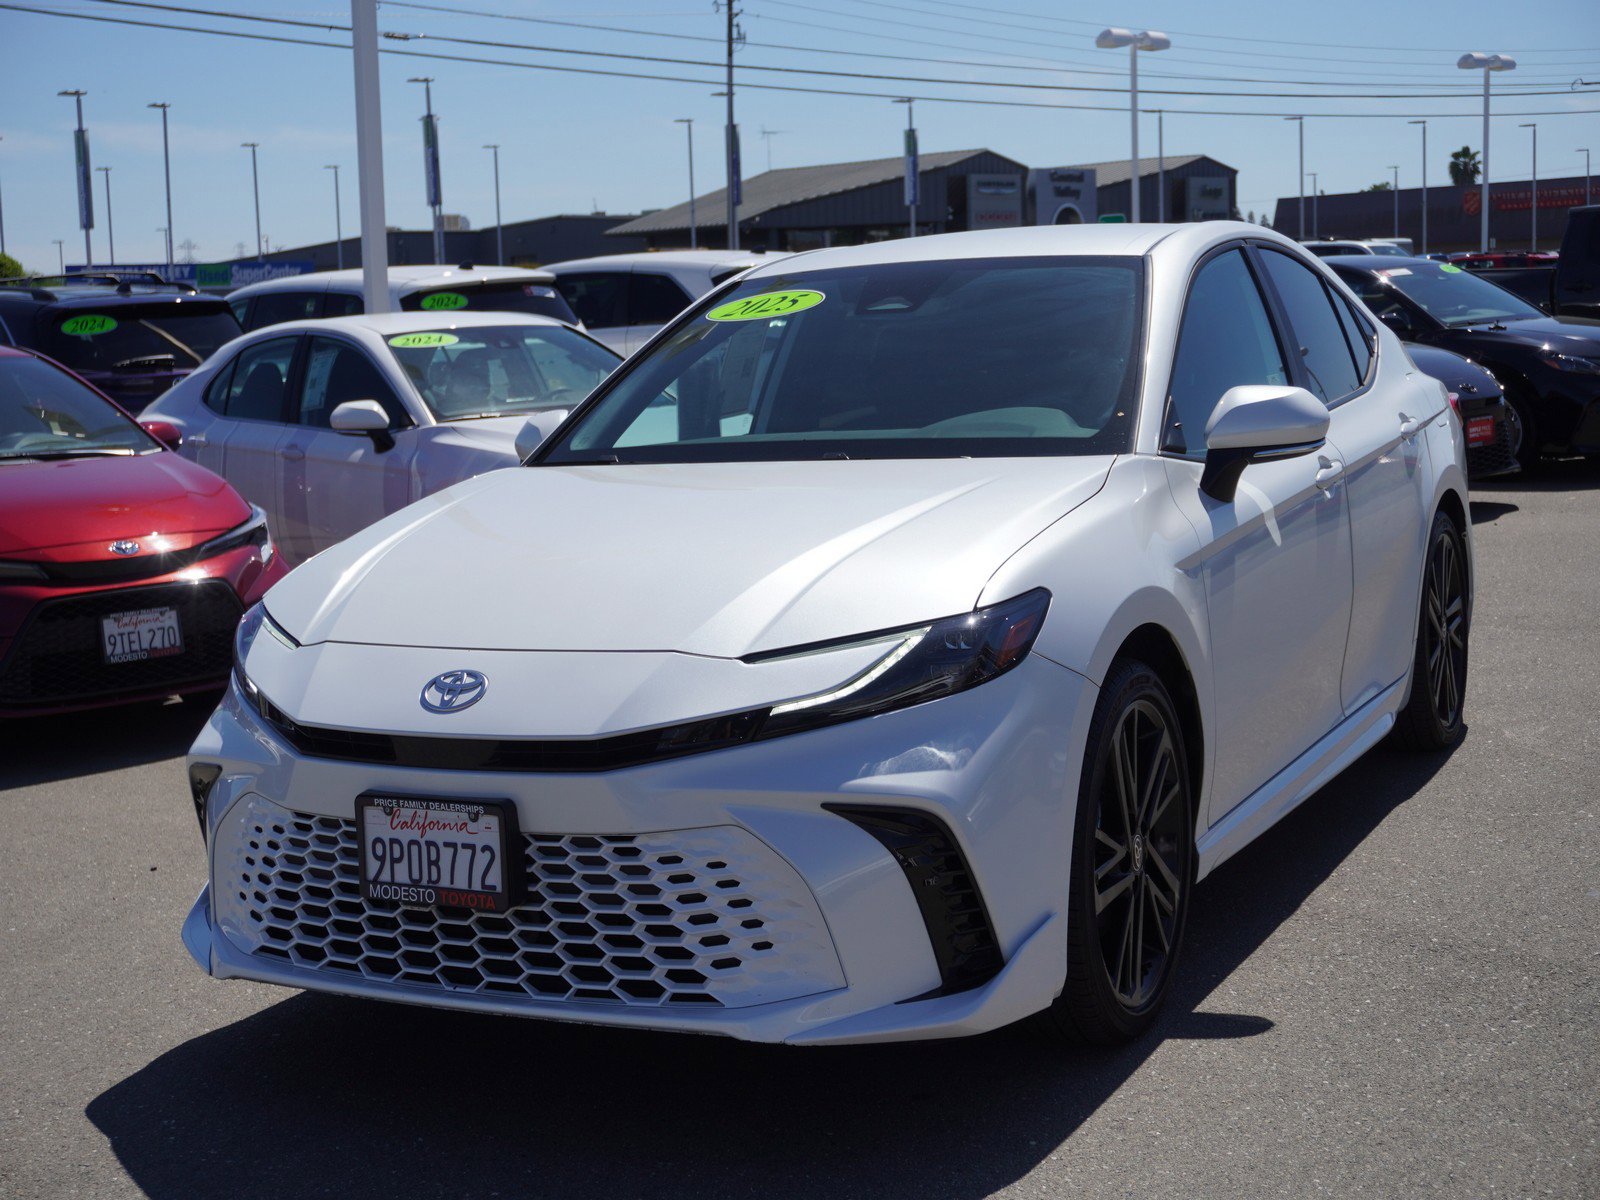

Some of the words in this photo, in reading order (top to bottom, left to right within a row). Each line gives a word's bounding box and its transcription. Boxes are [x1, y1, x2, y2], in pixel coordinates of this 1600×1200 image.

[430, 295, 459, 309] 2024
[720, 293, 810, 318] 2025
[70, 317, 106, 333] 2024
[401, 335, 443, 346] 2024
[117, 615, 165, 630] California
[108, 626, 177, 657] 9TEL270
[110, 651, 148, 663] MODESTO
[374, 798, 398, 808] PRICE
[400, 800, 427, 810] FAMILY
[429, 802, 485, 814] DEALERSHIPS
[389, 808, 479, 839] California
[369, 884, 436, 904] MODESTO
[441, 890, 496, 909] TOYOTA
